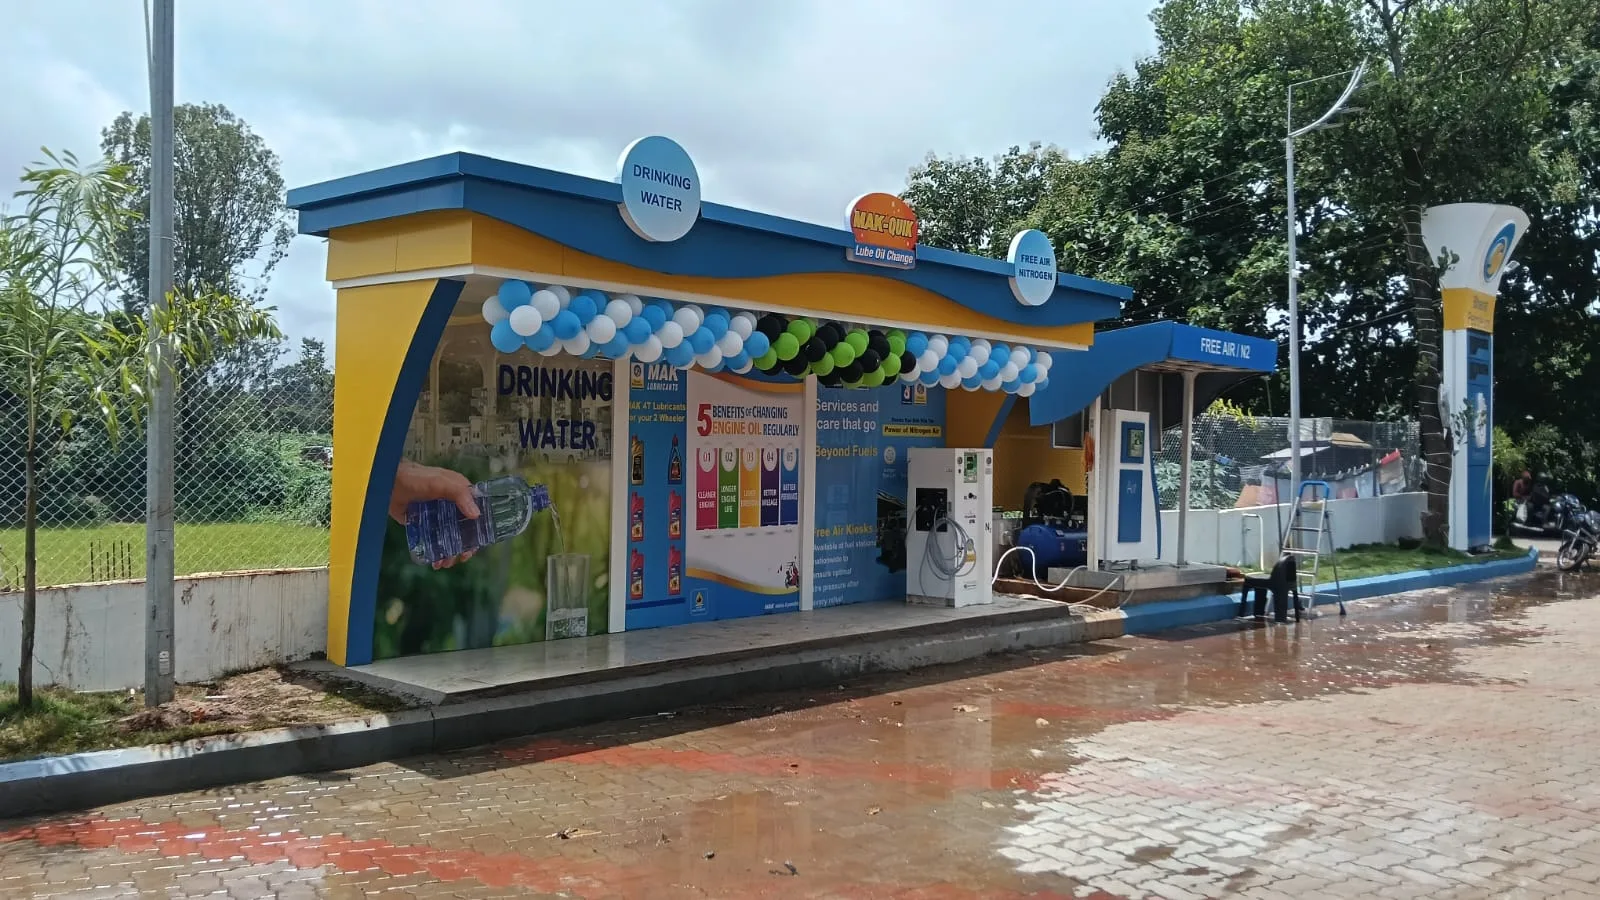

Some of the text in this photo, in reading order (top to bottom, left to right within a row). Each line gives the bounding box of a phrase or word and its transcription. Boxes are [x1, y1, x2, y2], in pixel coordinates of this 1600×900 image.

[633, 164, 691, 190] DRINKING
[641, 190, 682, 212] WATER
[853, 209, 913, 237] MAK-QUIK
[855, 244, 914, 265] Lube Oil Change
[1021, 254, 1051, 266] FREE AIR
[1018, 268, 1052, 281] NITROGEN
[1200, 337, 1222, 354] FREE
[1222, 341, 1236, 357] AIR
[1240, 344, 1251, 359] N2
[648, 363, 679, 382] MAK
[498, 364, 613, 402] DRINKING
[647, 382, 679, 392] LUBRICANTS
[653, 402, 687, 411] Lubricants
[712, 405, 745, 419] BENEFITS
[752, 406, 788, 420] CHANGING
[860, 399, 879, 413] and
[653, 413, 659, 422] 2
[659, 414, 686, 423] Wheeler
[697, 403, 713, 437] 5
[816, 419, 840, 430] care
[842, 417, 861, 430] that
[863, 420, 877, 433] go
[519, 418, 596, 450] WATER
[712, 422, 800, 437] ENGINE OIL REGULARLY
[703, 452, 711, 462] 01
[725, 452, 733, 462] 02
[767, 452, 774, 462] 04
[816, 444, 878, 461] Beyond Fuels
[832, 525, 844, 536] Air
[845, 523, 873, 534] Kiosks
